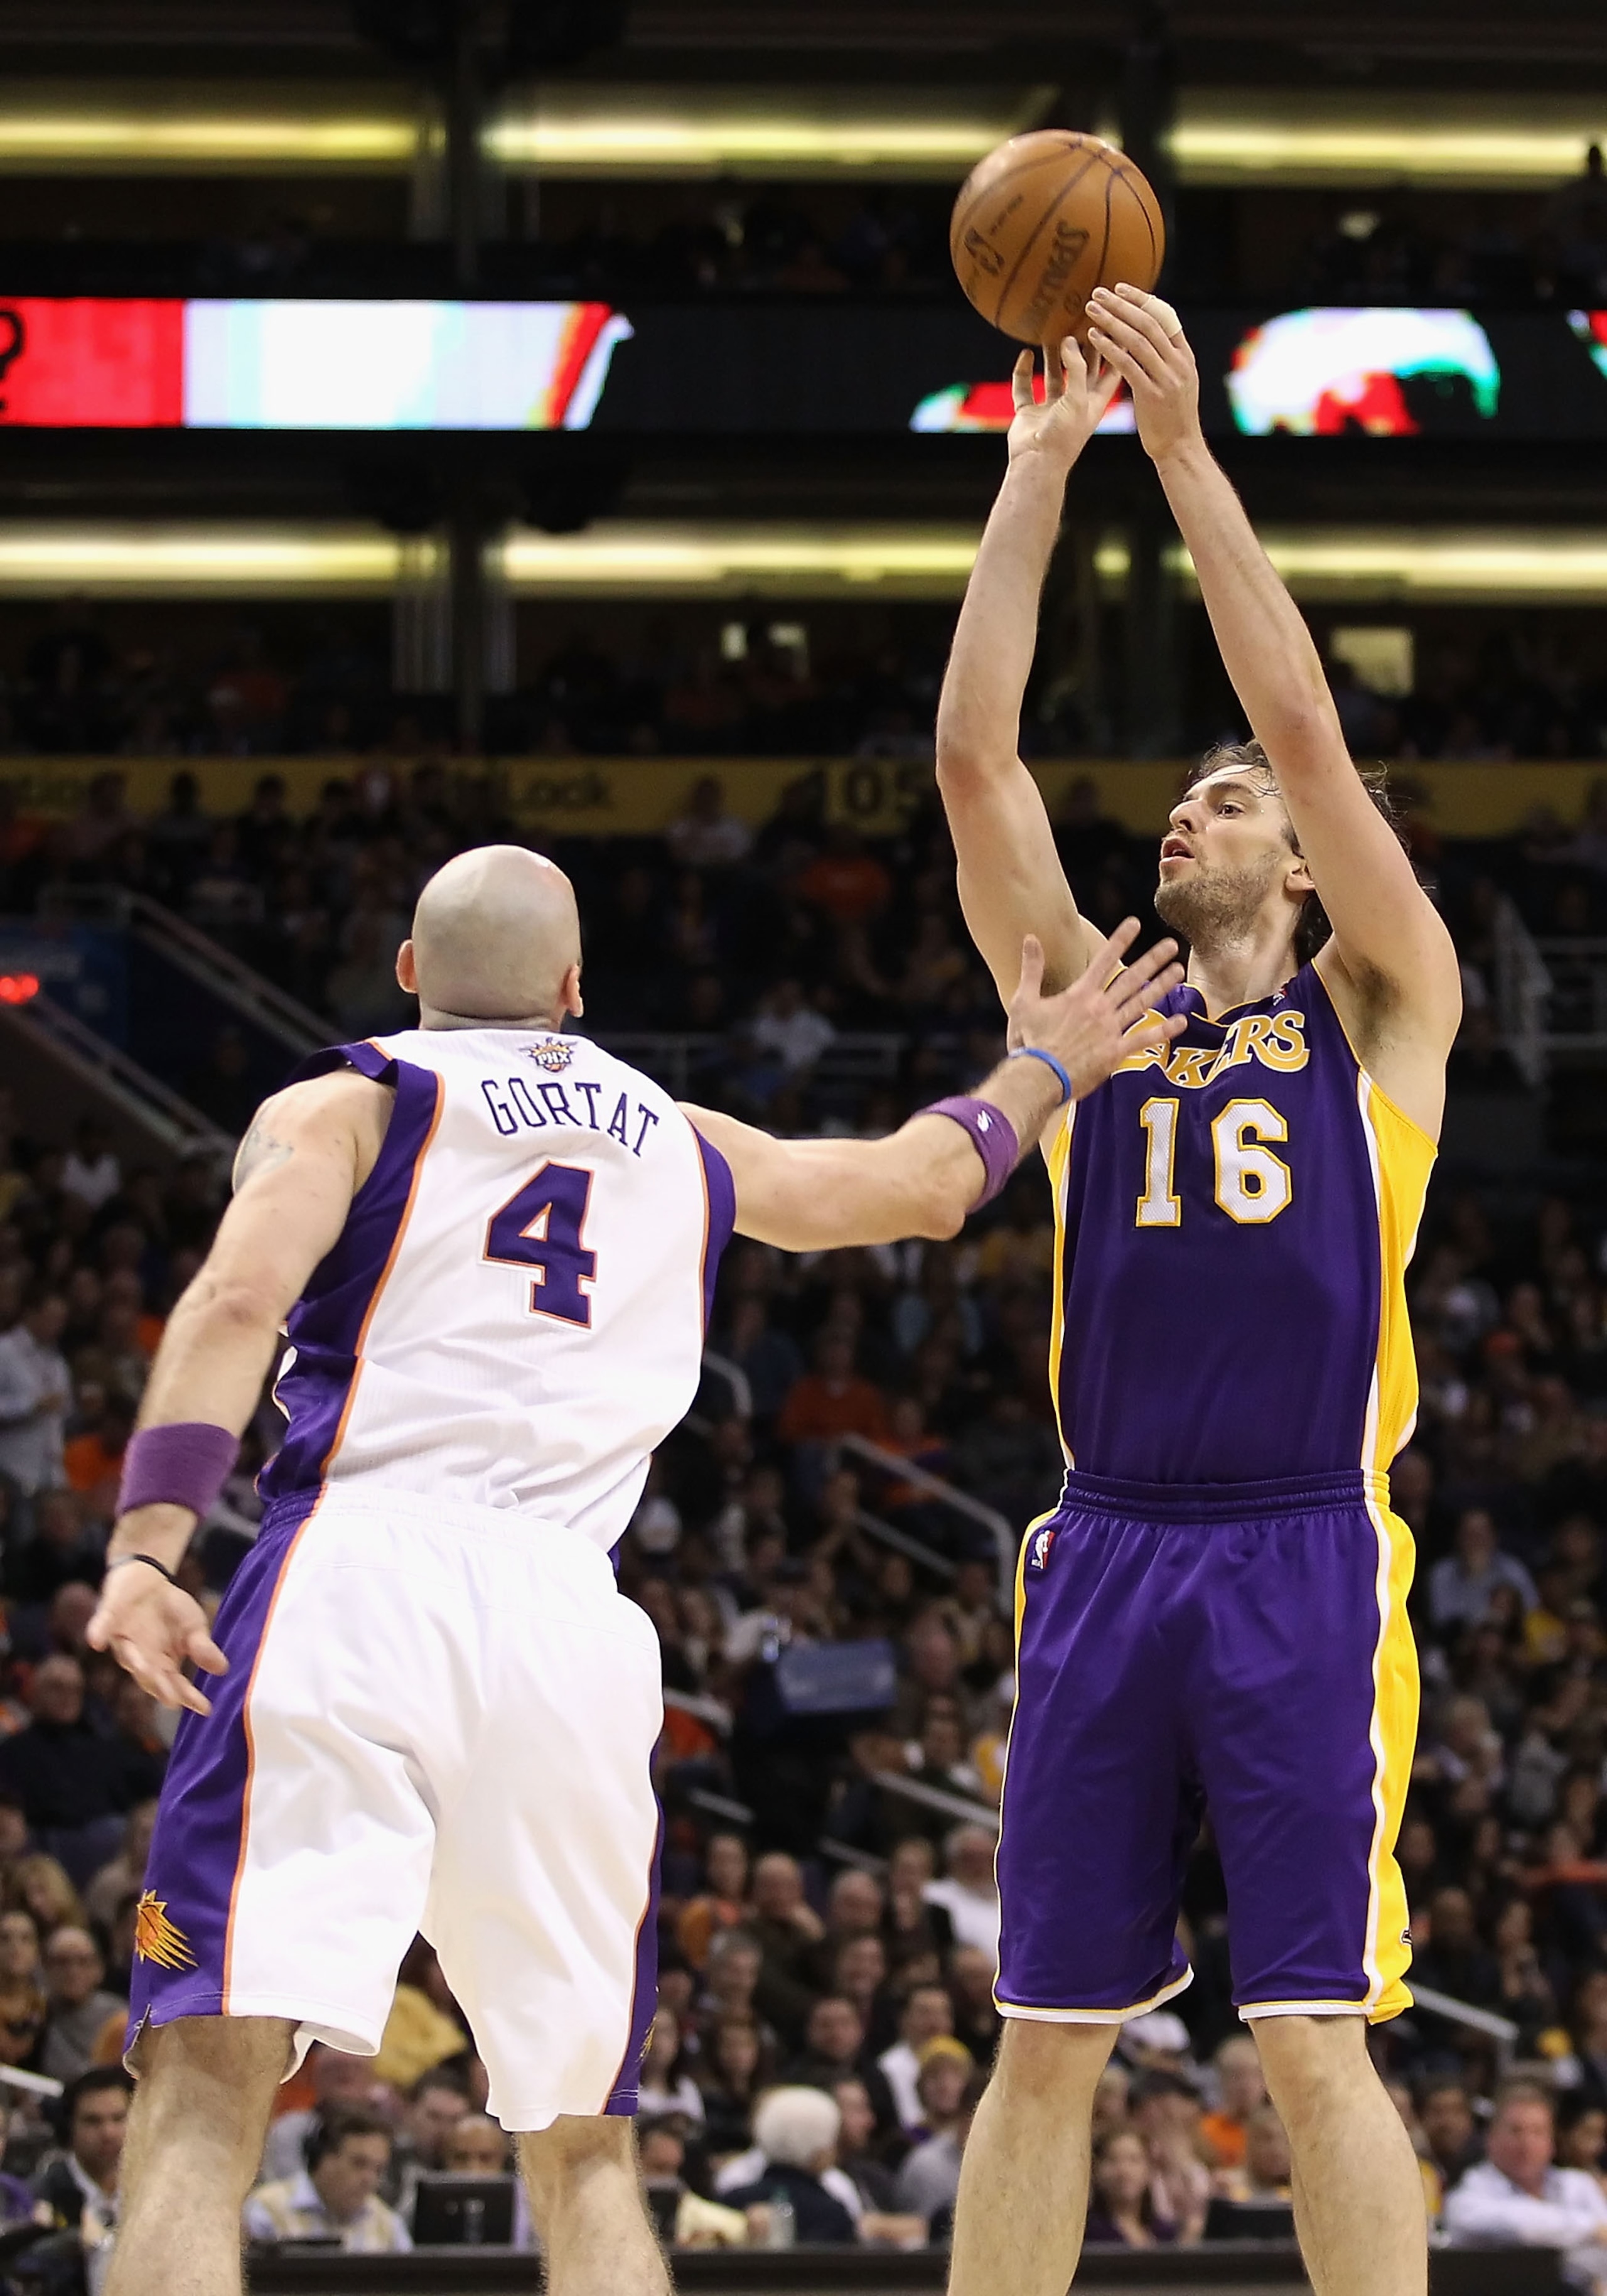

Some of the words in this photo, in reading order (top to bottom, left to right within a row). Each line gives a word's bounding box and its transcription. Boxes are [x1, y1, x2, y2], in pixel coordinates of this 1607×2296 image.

[537, 1050, 570, 1066] PHX
[480, 1077, 660, 1158] GORTAT
[1136, 1097, 1293, 1227] 16
[482, 1158, 598, 1330] 4
